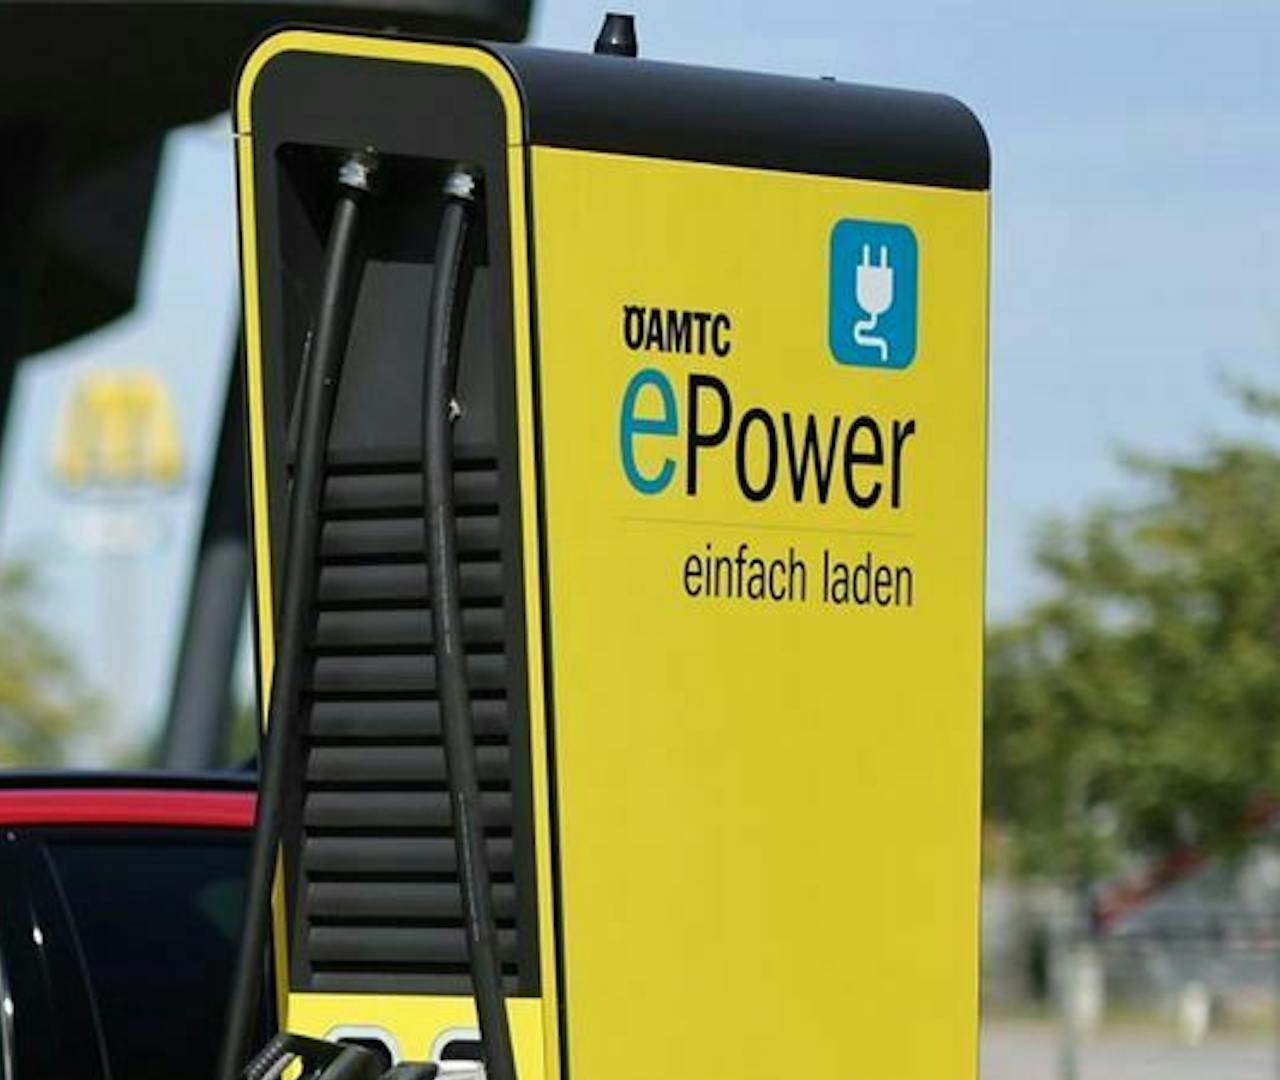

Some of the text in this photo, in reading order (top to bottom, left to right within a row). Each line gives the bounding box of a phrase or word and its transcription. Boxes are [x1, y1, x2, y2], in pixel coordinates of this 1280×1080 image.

[623, 305, 731, 357] ÖAMTC
[619, 367, 916, 509] ePower
[683, 543, 913, 606] einfach laden
